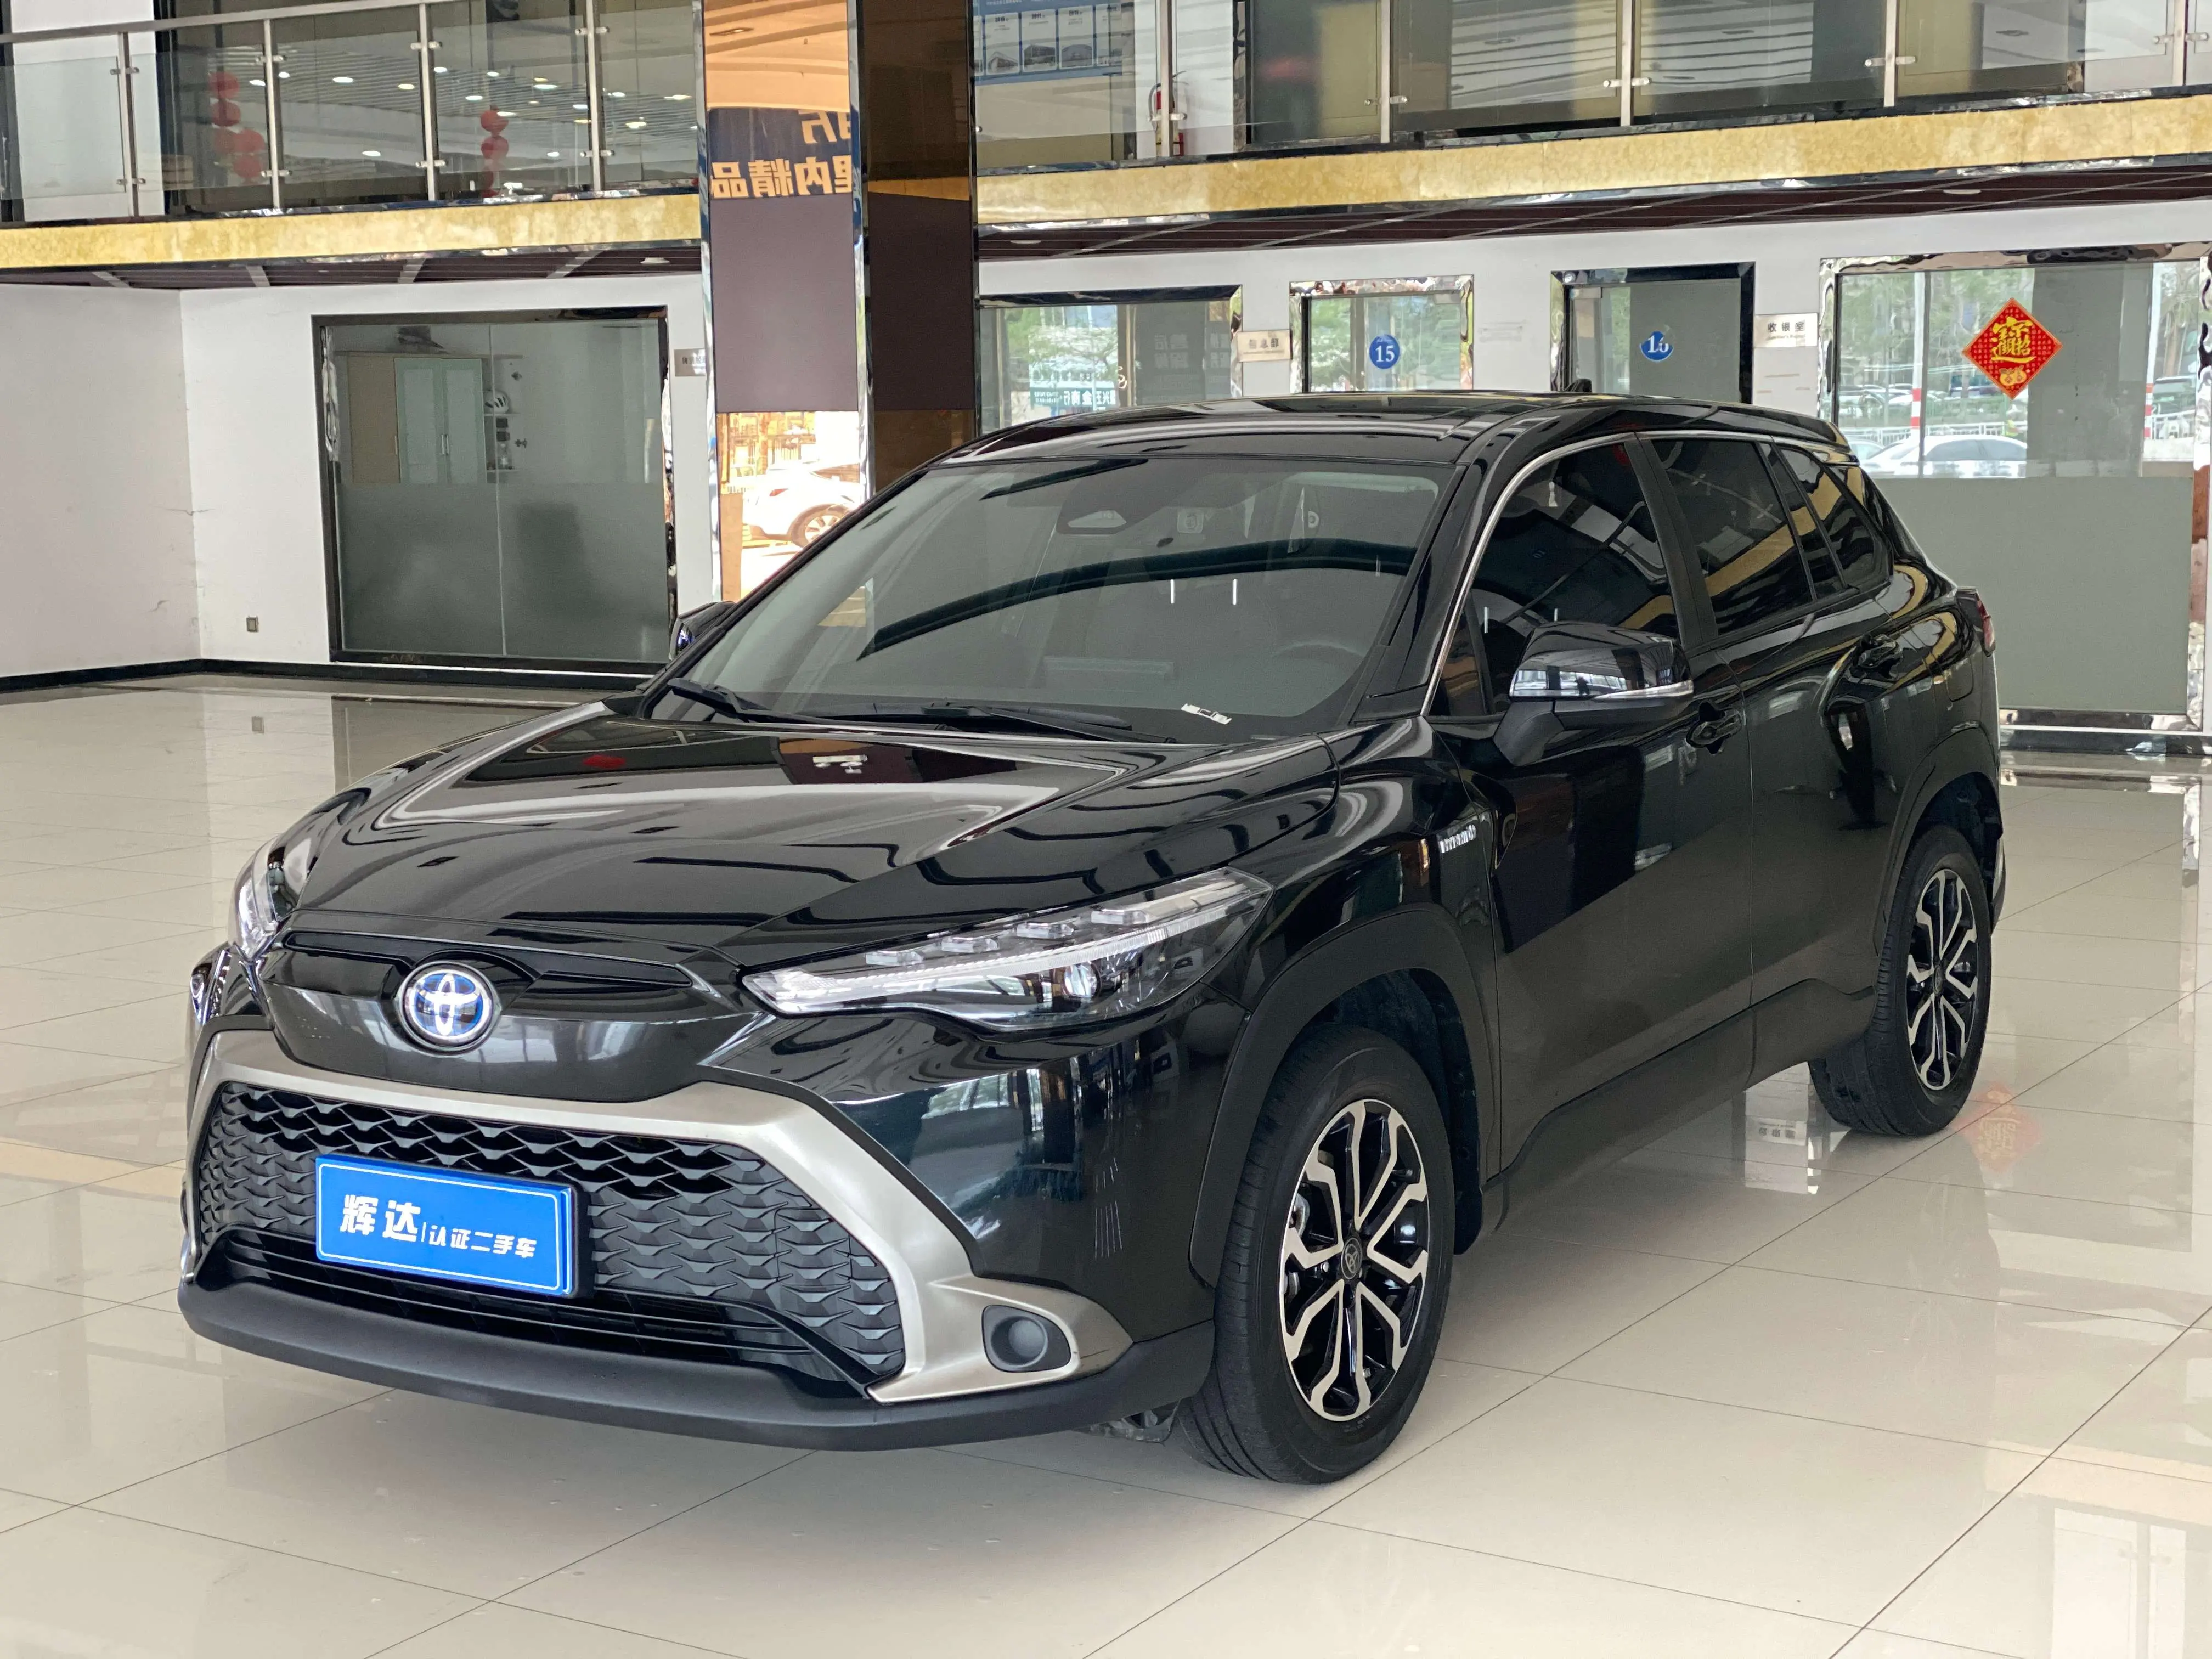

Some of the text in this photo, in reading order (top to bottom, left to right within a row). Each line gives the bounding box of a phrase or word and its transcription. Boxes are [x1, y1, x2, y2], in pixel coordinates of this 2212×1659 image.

[1767, 321, 1805, 332] 收银室
[1375, 345, 1395, 362] 15
[339, 1194, 537, 1259] 辉达 认证二手车
